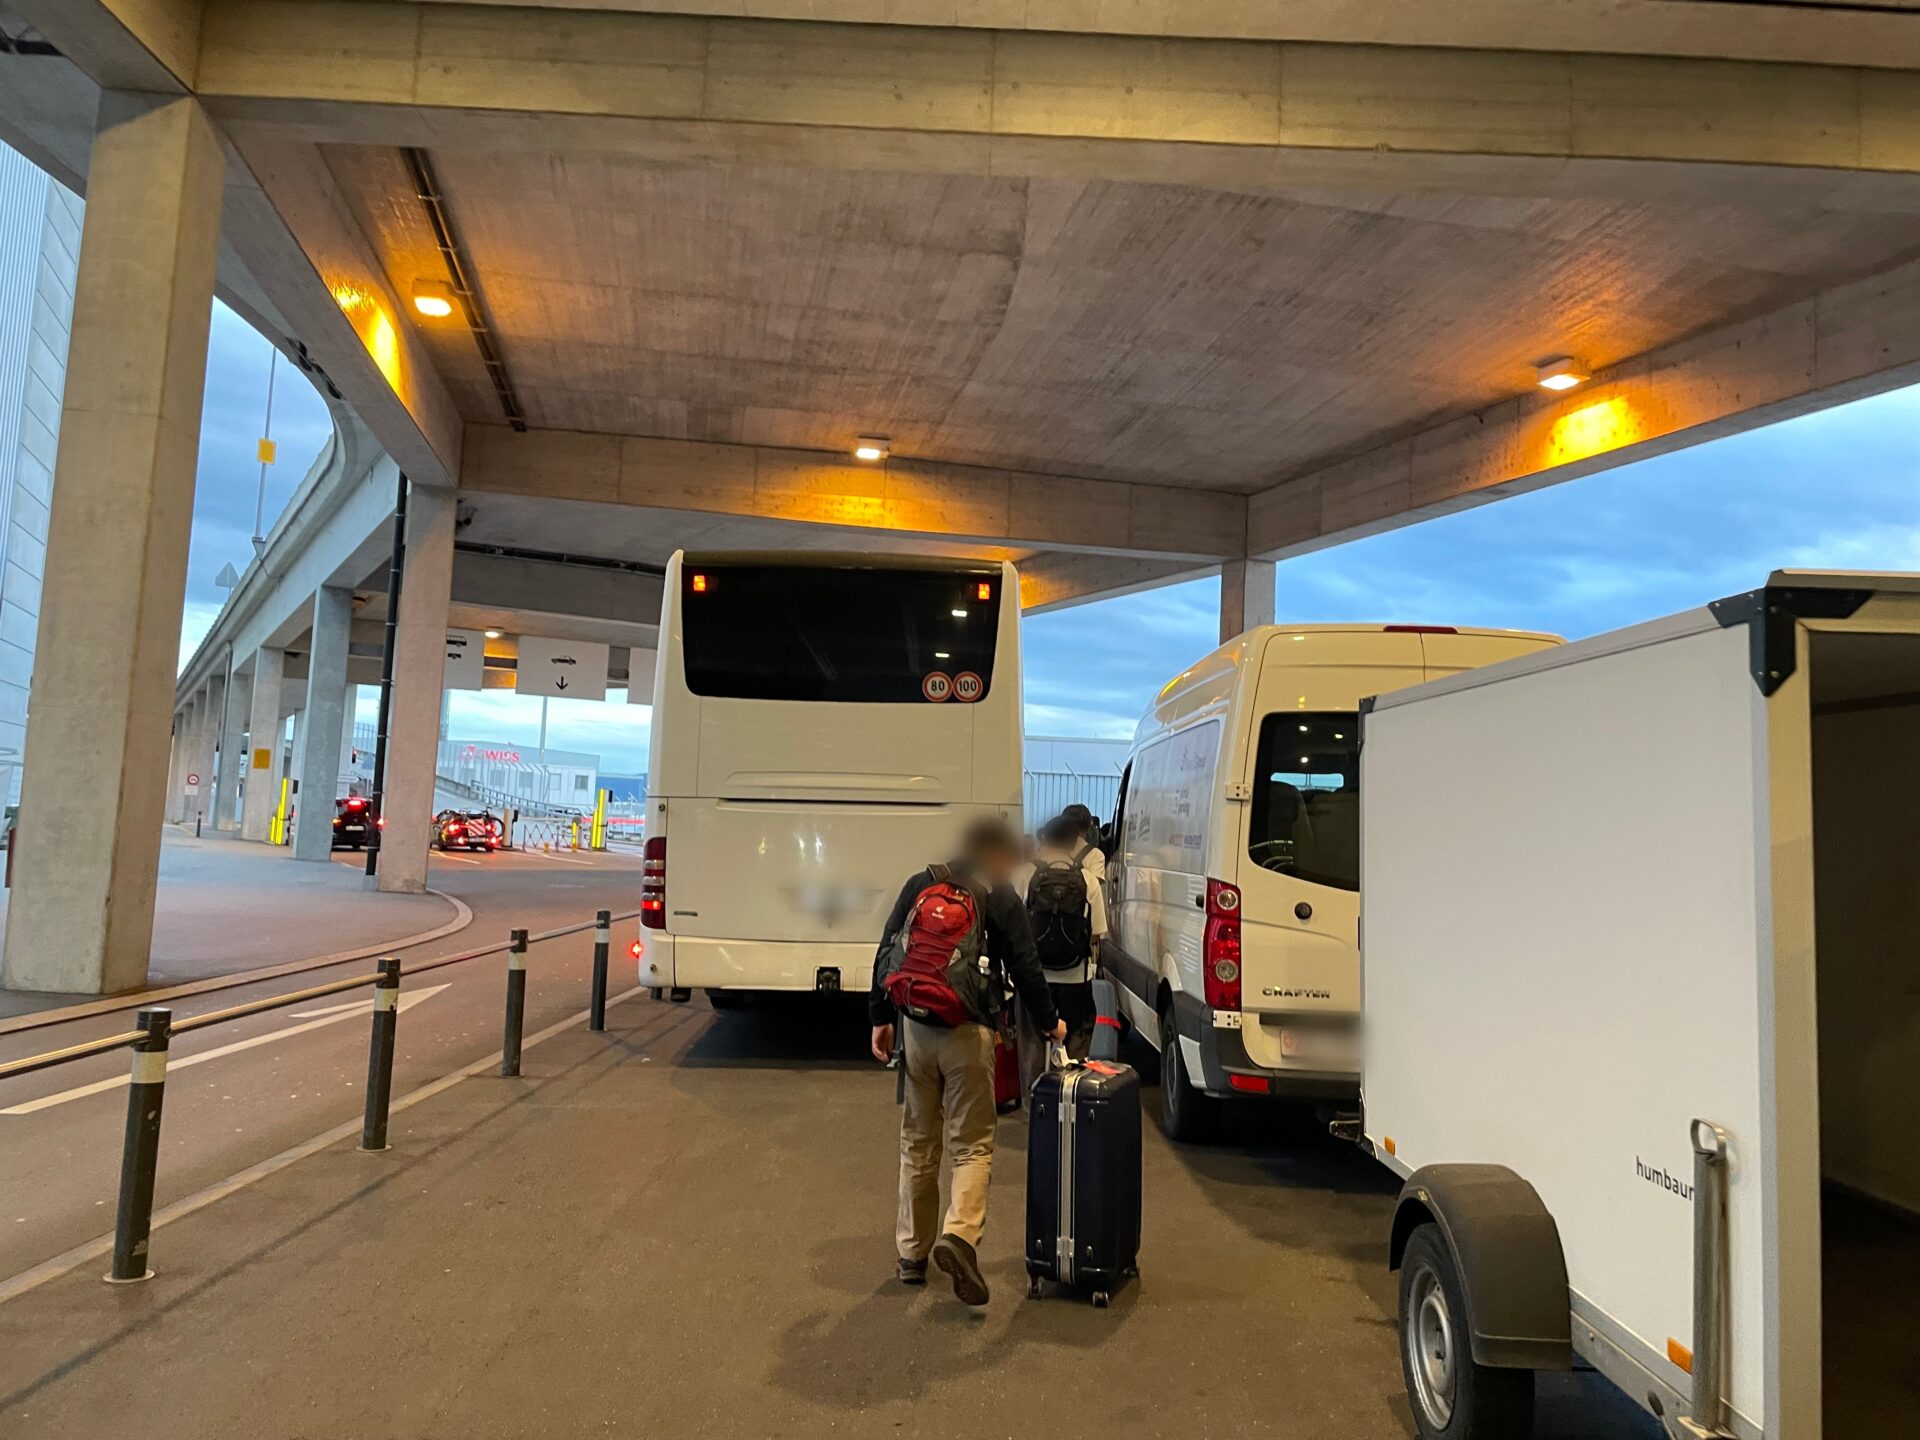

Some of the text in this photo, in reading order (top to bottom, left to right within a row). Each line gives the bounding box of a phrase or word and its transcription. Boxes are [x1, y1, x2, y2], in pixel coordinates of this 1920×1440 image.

[931, 680, 945, 692] 80
[959, 680, 977, 692] 100
[1262, 985, 1330, 999] CRAFTER
[1636, 1155, 1695, 1201] humbaur
